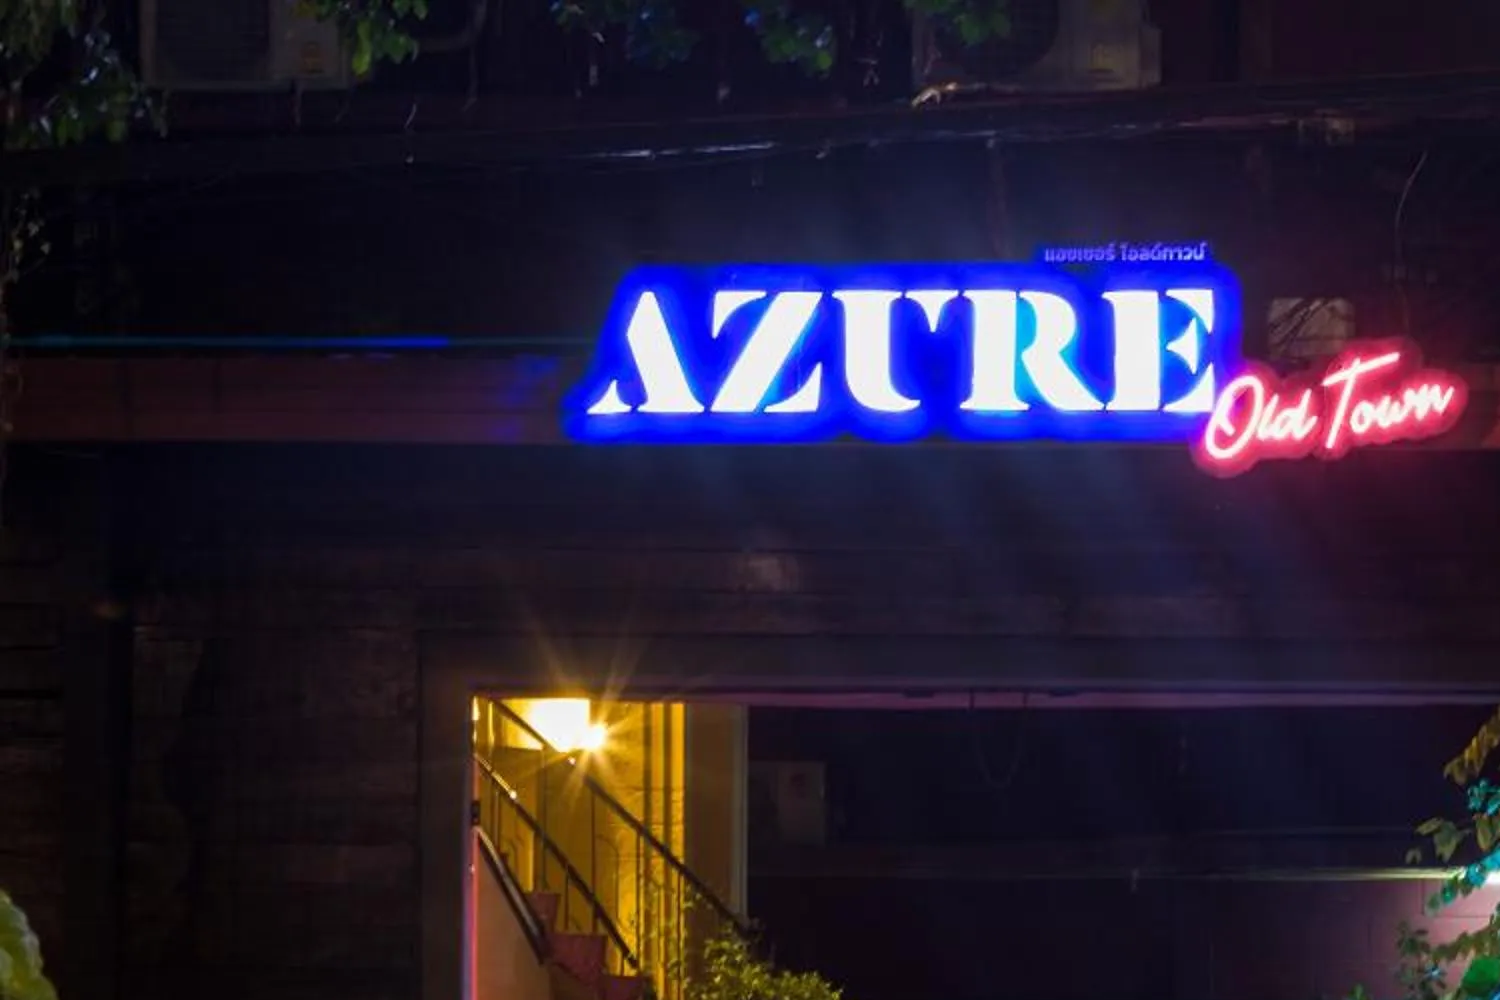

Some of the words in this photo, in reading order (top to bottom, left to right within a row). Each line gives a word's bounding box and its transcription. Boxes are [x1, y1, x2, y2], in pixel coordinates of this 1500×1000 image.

[587, 288, 1215, 414] AZURE
[1204, 375, 1318, 460] Old
[1321, 351, 1455, 449] Town
